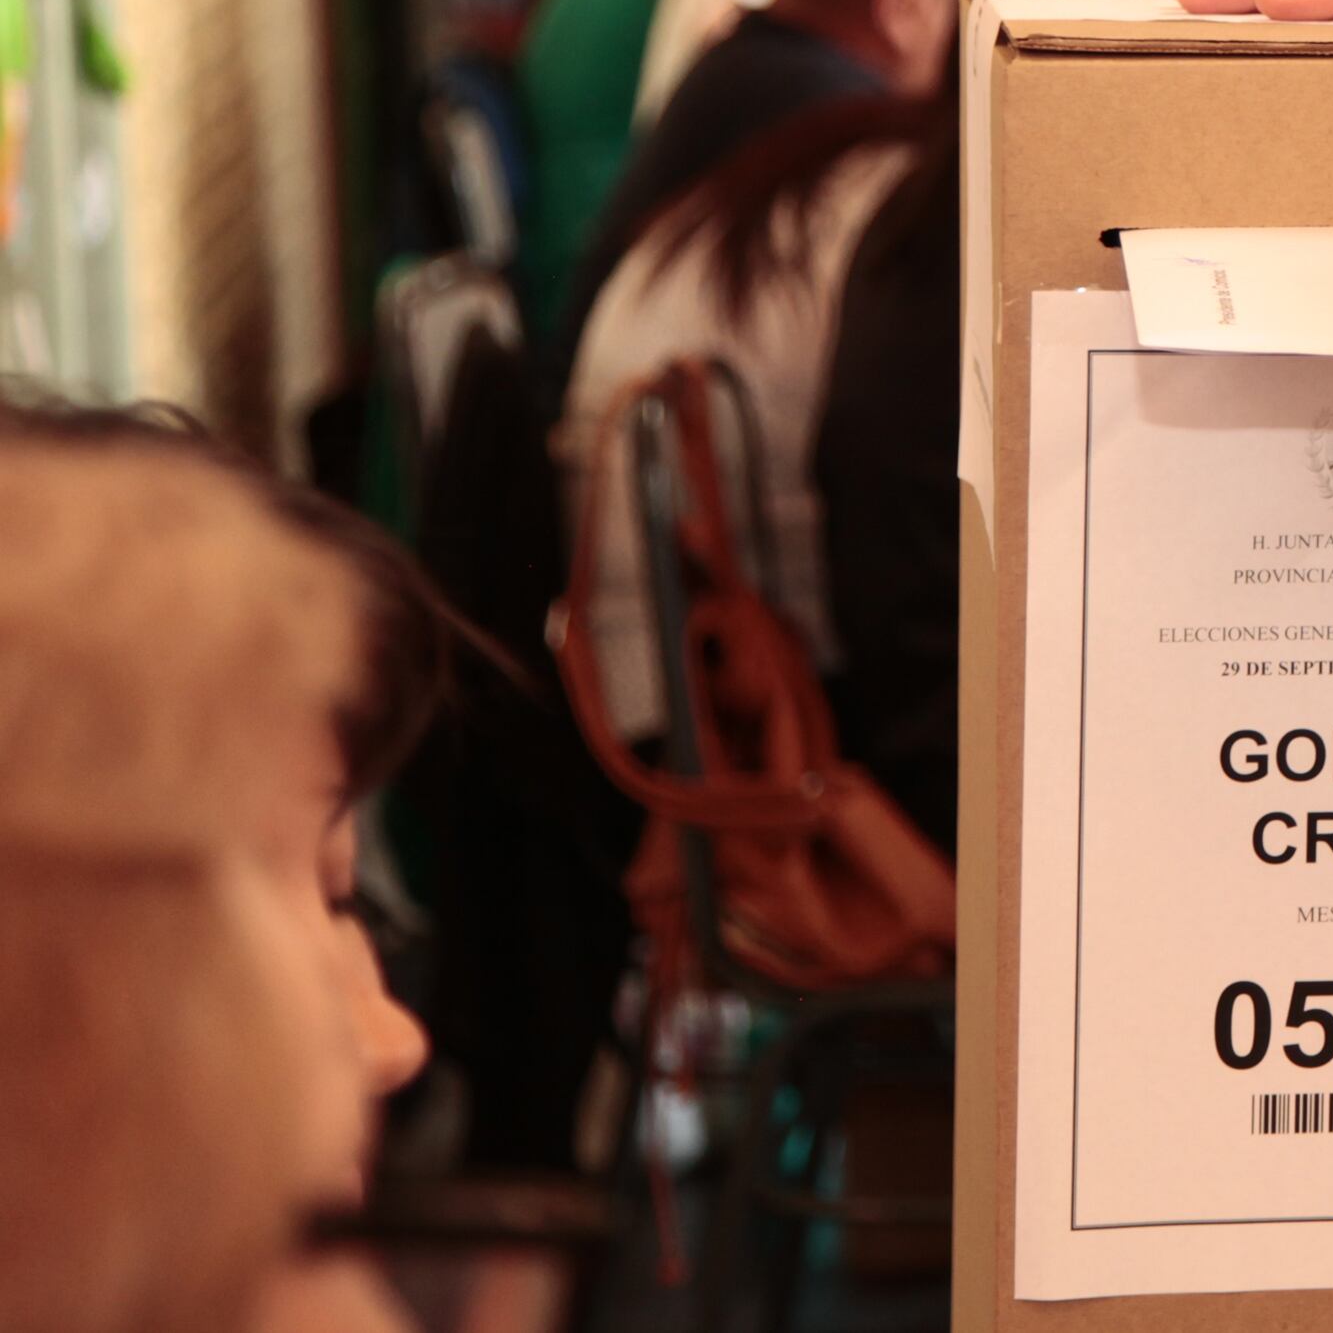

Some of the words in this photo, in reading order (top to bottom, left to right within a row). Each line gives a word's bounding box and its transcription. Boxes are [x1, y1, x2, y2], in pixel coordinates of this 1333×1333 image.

[1252, 535, 1270, 551] H.
[1159, 626, 1280, 643] ELECCIONES
[1221, 661, 1241, 677] 29
[1245, 660, 1273, 677] DE
